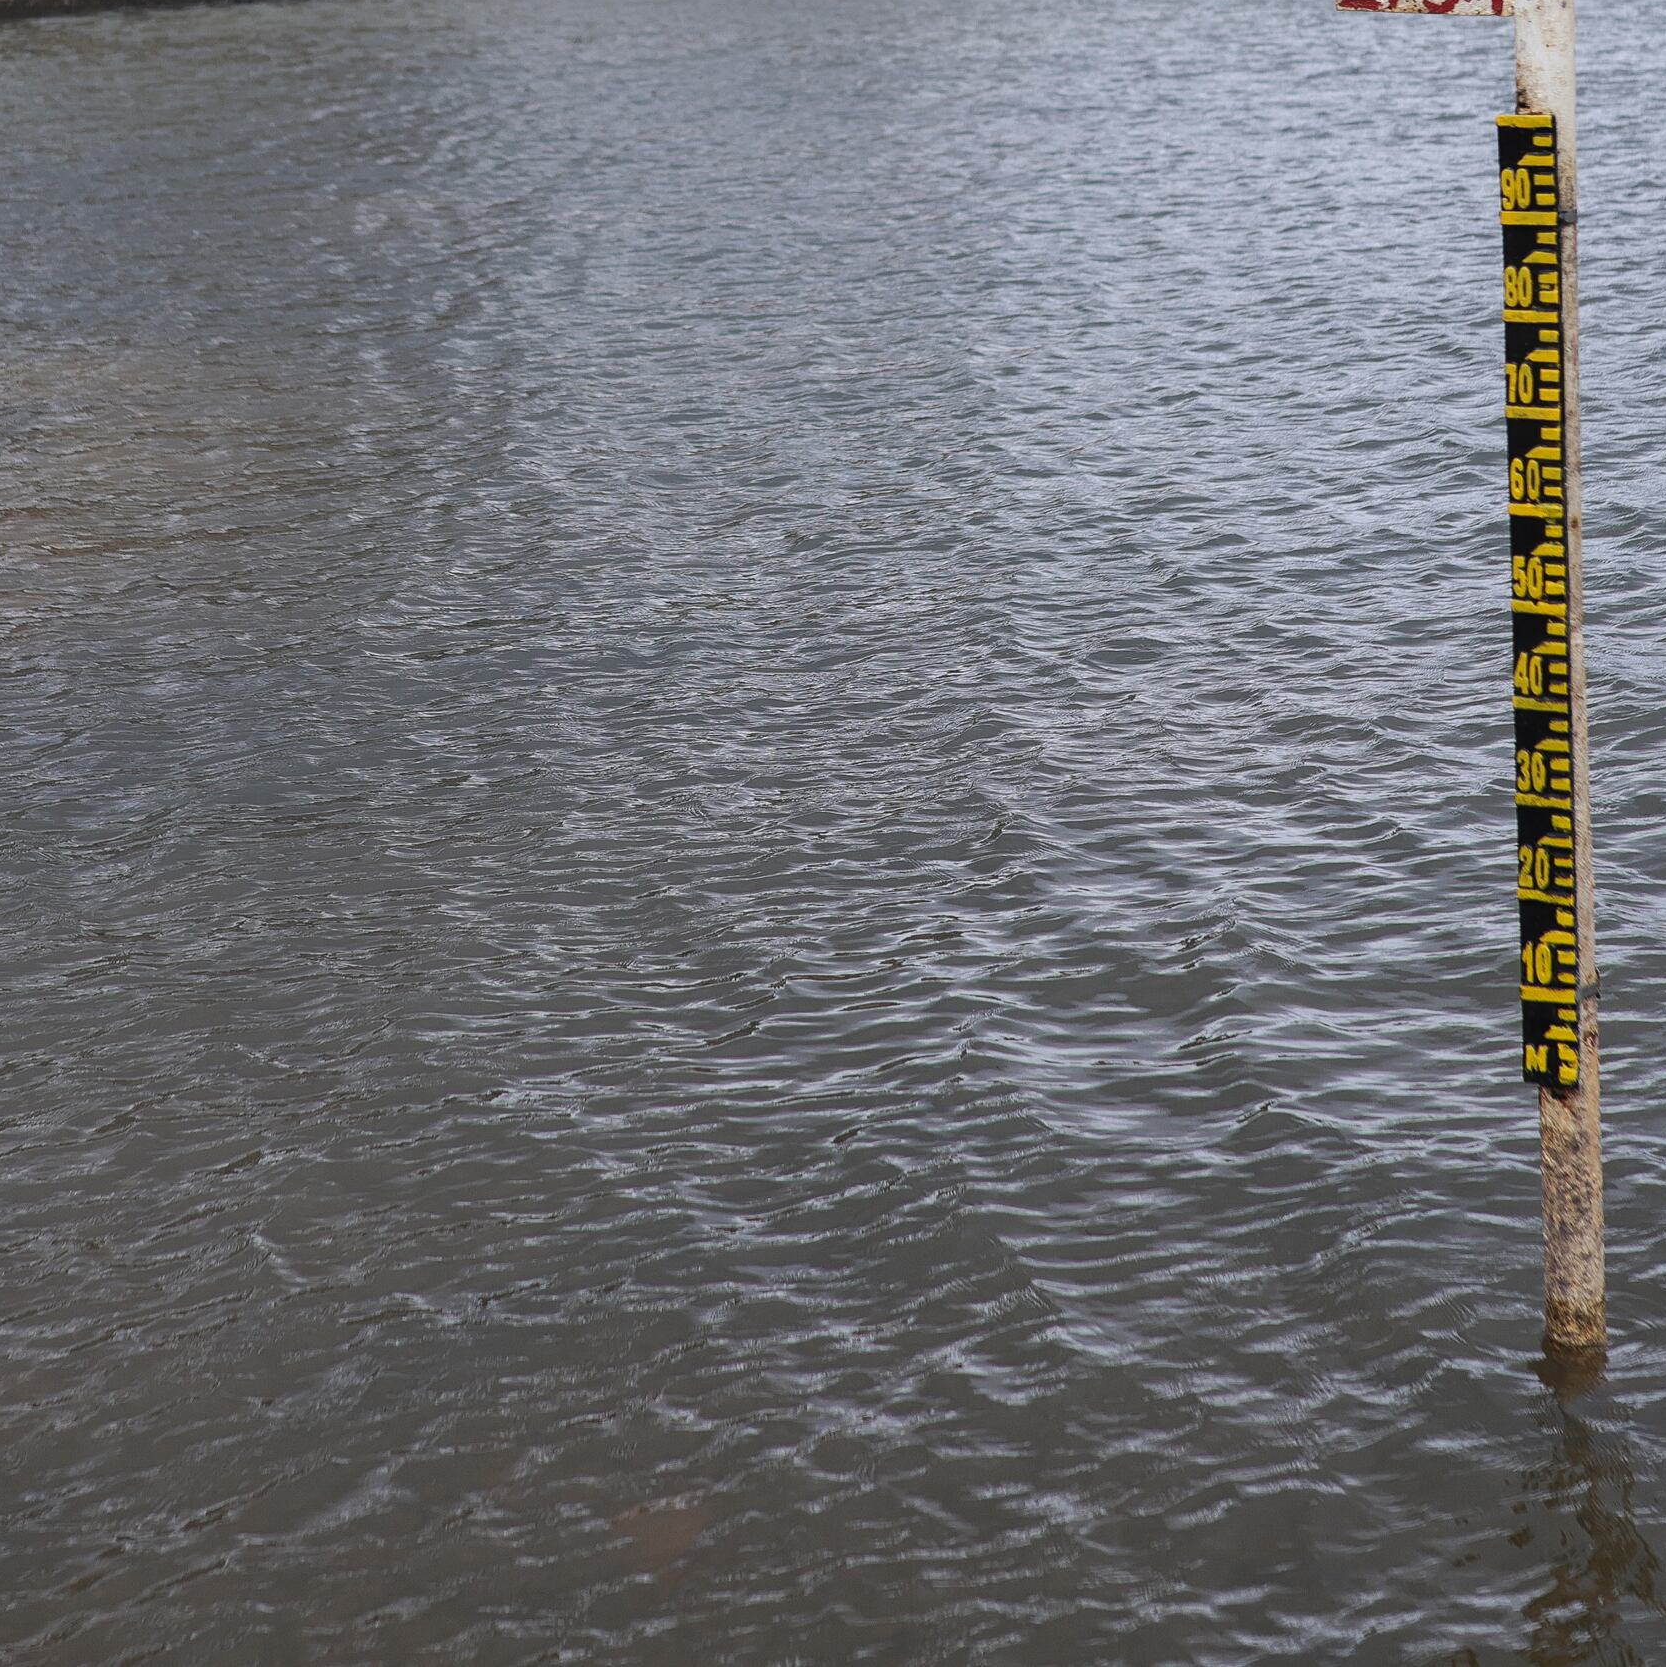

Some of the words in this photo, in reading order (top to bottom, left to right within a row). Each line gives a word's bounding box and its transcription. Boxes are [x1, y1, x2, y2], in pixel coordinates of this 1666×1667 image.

[1500, 168, 1530, 210] 90
[1504, 266, 1532, 307] 80
[1504, 363, 1533, 404] 70
[1510, 457, 1540, 501] 60
[1512, 555, 1543, 599] 50
[1513, 651, 1543, 696] 40
[1516, 749, 1546, 793] 30
[1518, 845, 1550, 890] 20
[1522, 941, 1552, 985] 10
